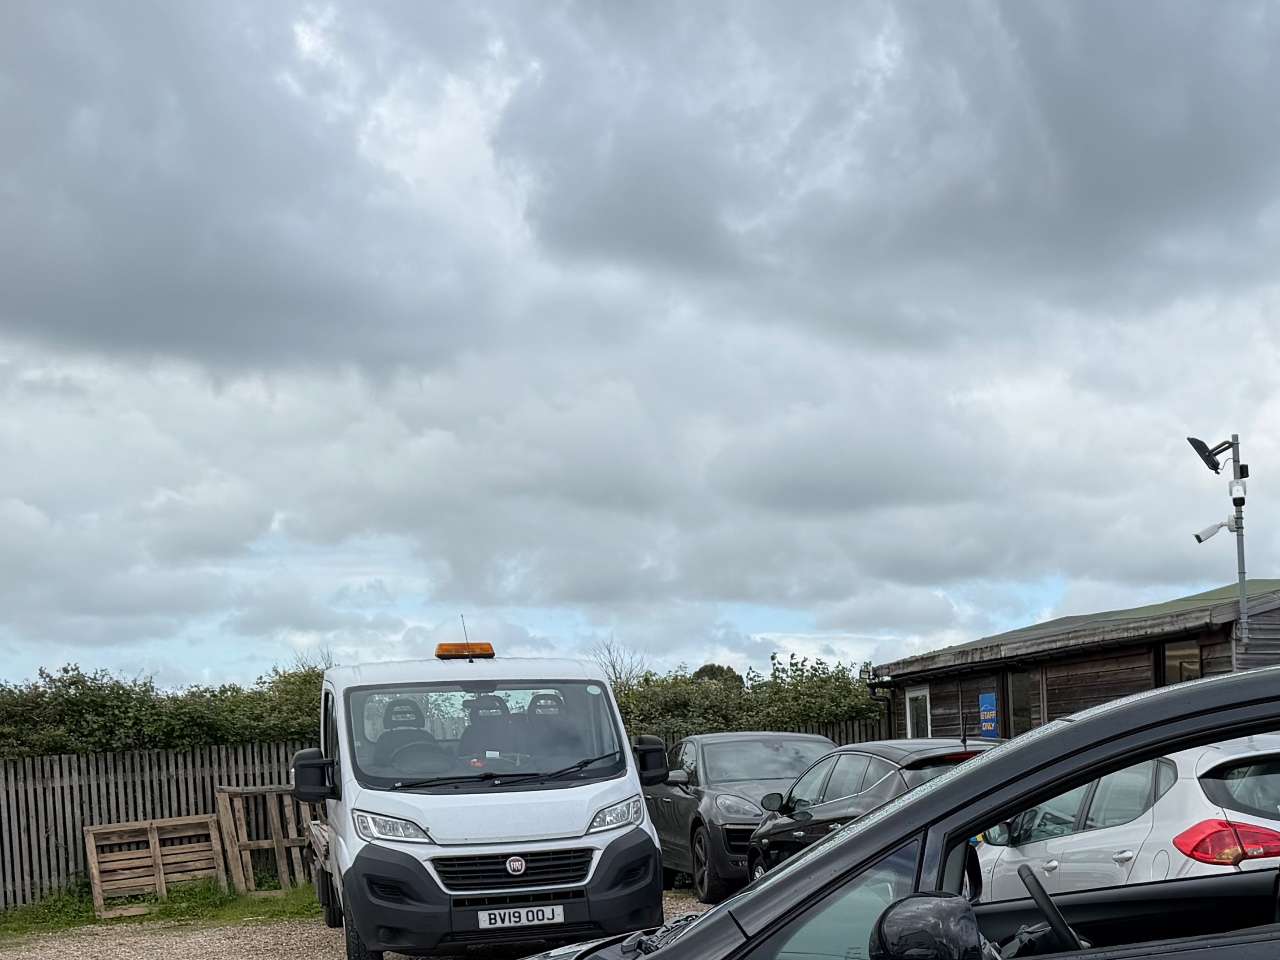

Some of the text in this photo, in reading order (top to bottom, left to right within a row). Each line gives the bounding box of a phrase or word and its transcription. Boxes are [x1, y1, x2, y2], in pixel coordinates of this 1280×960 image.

[980, 711, 997, 720] STAFF
[982, 722, 995, 730] ONLY
[510, 861, 522, 871] FIAT
[488, 911, 522, 926] BV19
